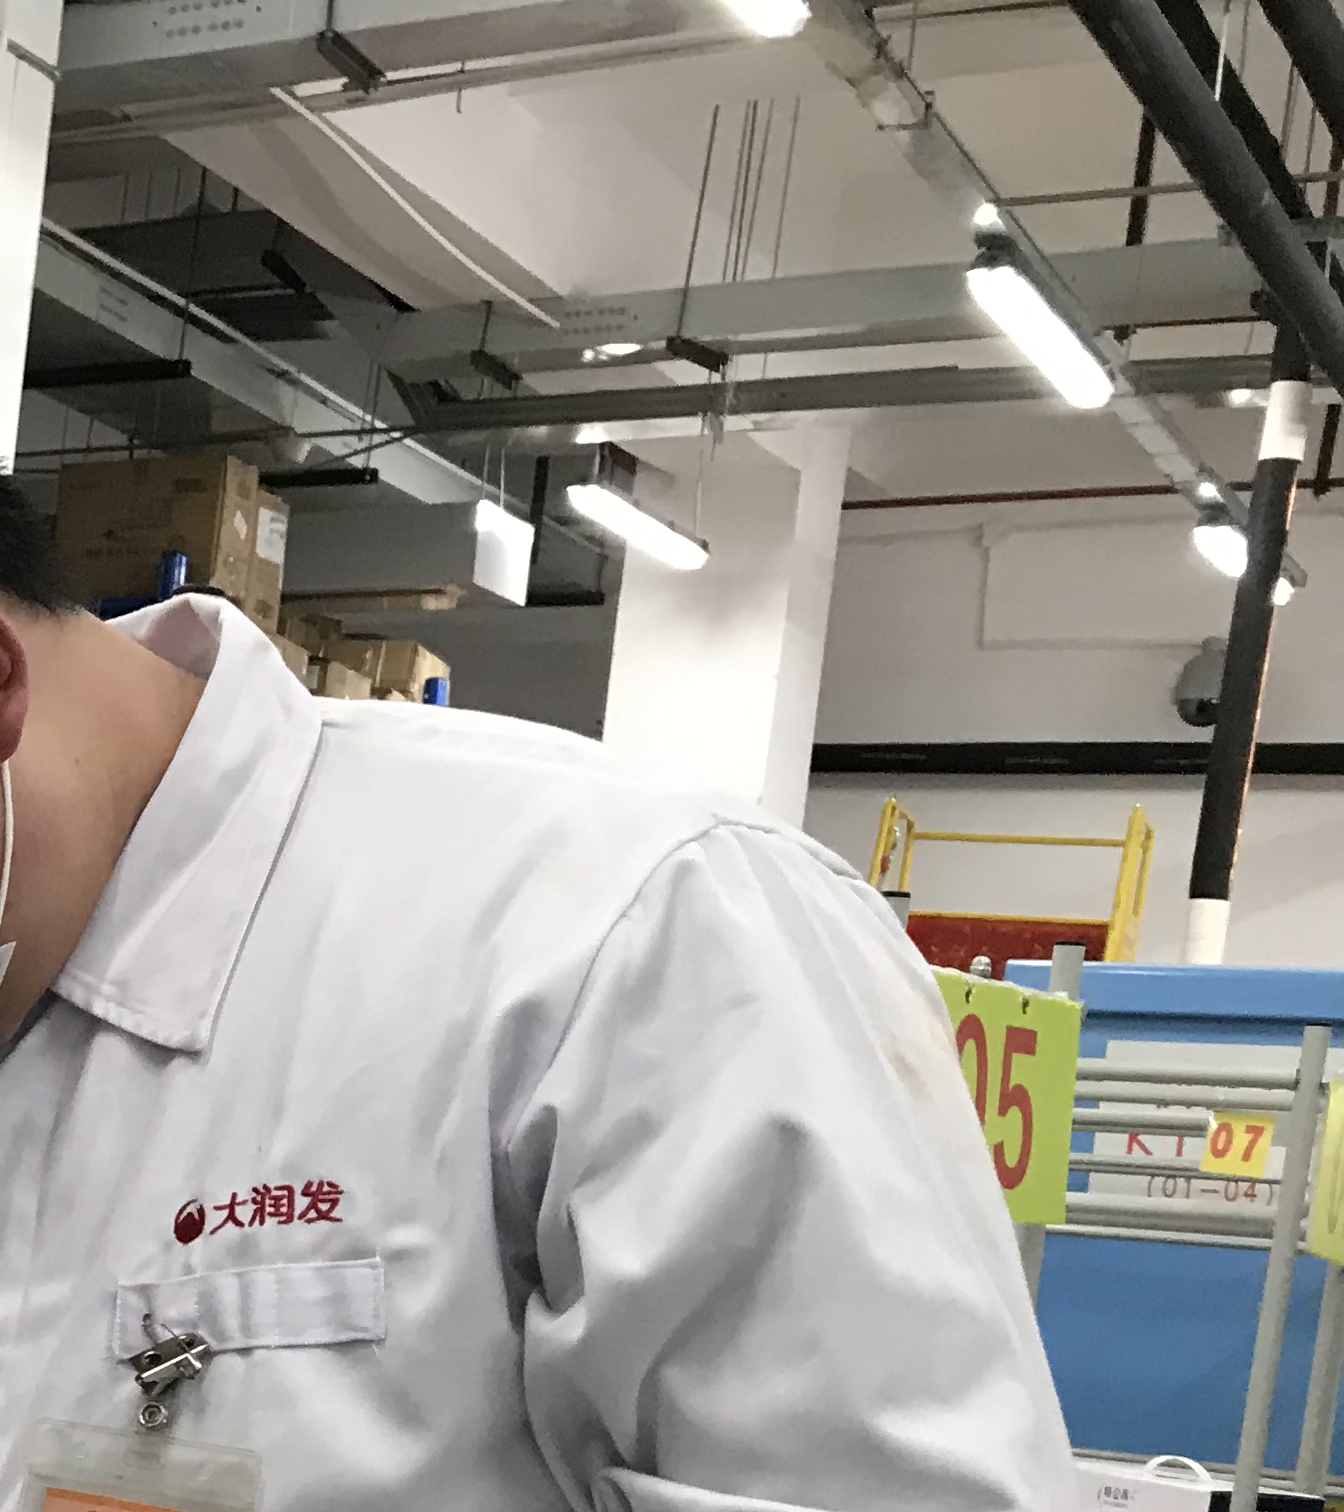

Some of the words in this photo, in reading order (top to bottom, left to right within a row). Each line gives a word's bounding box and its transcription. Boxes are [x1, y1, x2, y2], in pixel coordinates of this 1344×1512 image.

[955, 1013, 1038, 1190] 05
[1209, 1122, 1265, 1163] 07
[209, 1179, 344, 1236] 大润发
